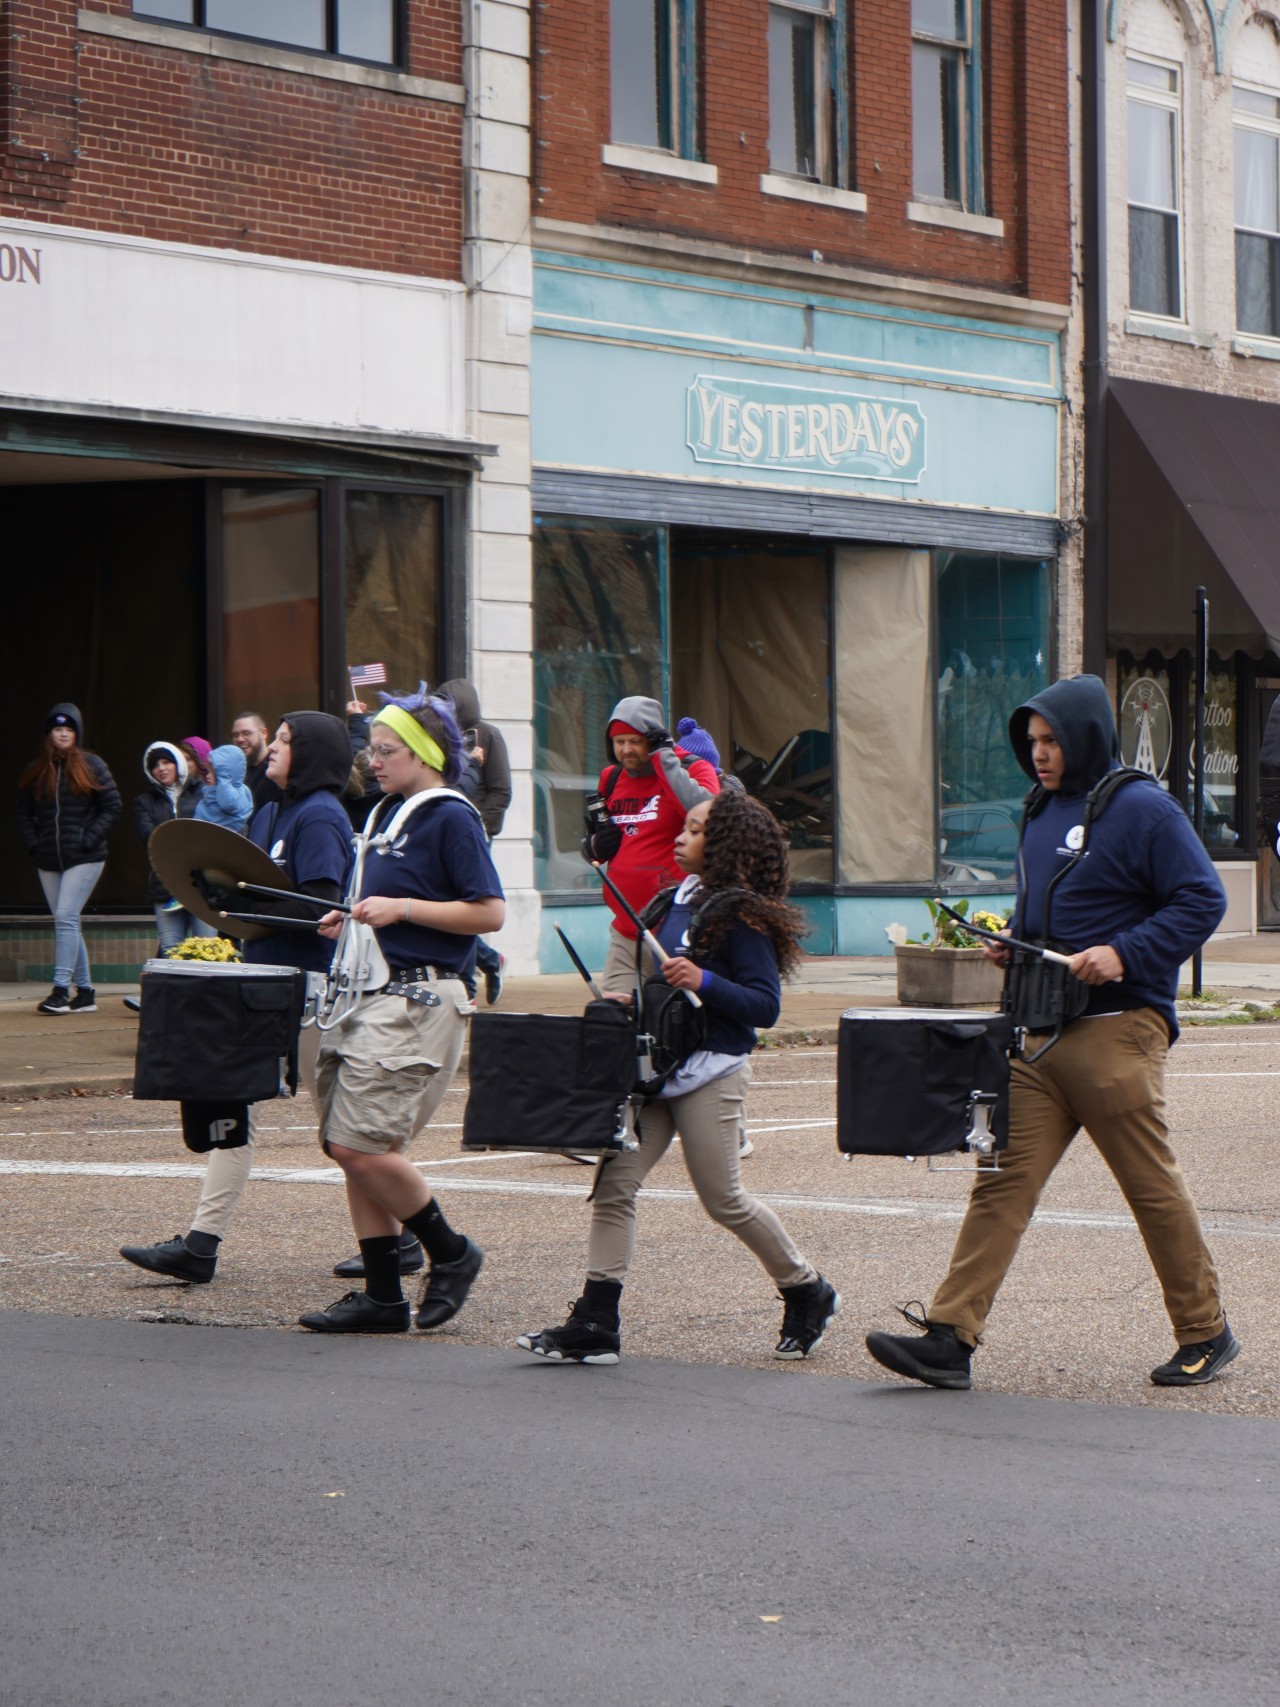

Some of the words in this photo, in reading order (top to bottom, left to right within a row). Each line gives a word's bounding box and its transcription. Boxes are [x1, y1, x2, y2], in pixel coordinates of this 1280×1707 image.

[0, 243, 42, 285] ON
[696, 384, 919, 467] YESTERDAYS
[616, 814, 648, 823] BAND
